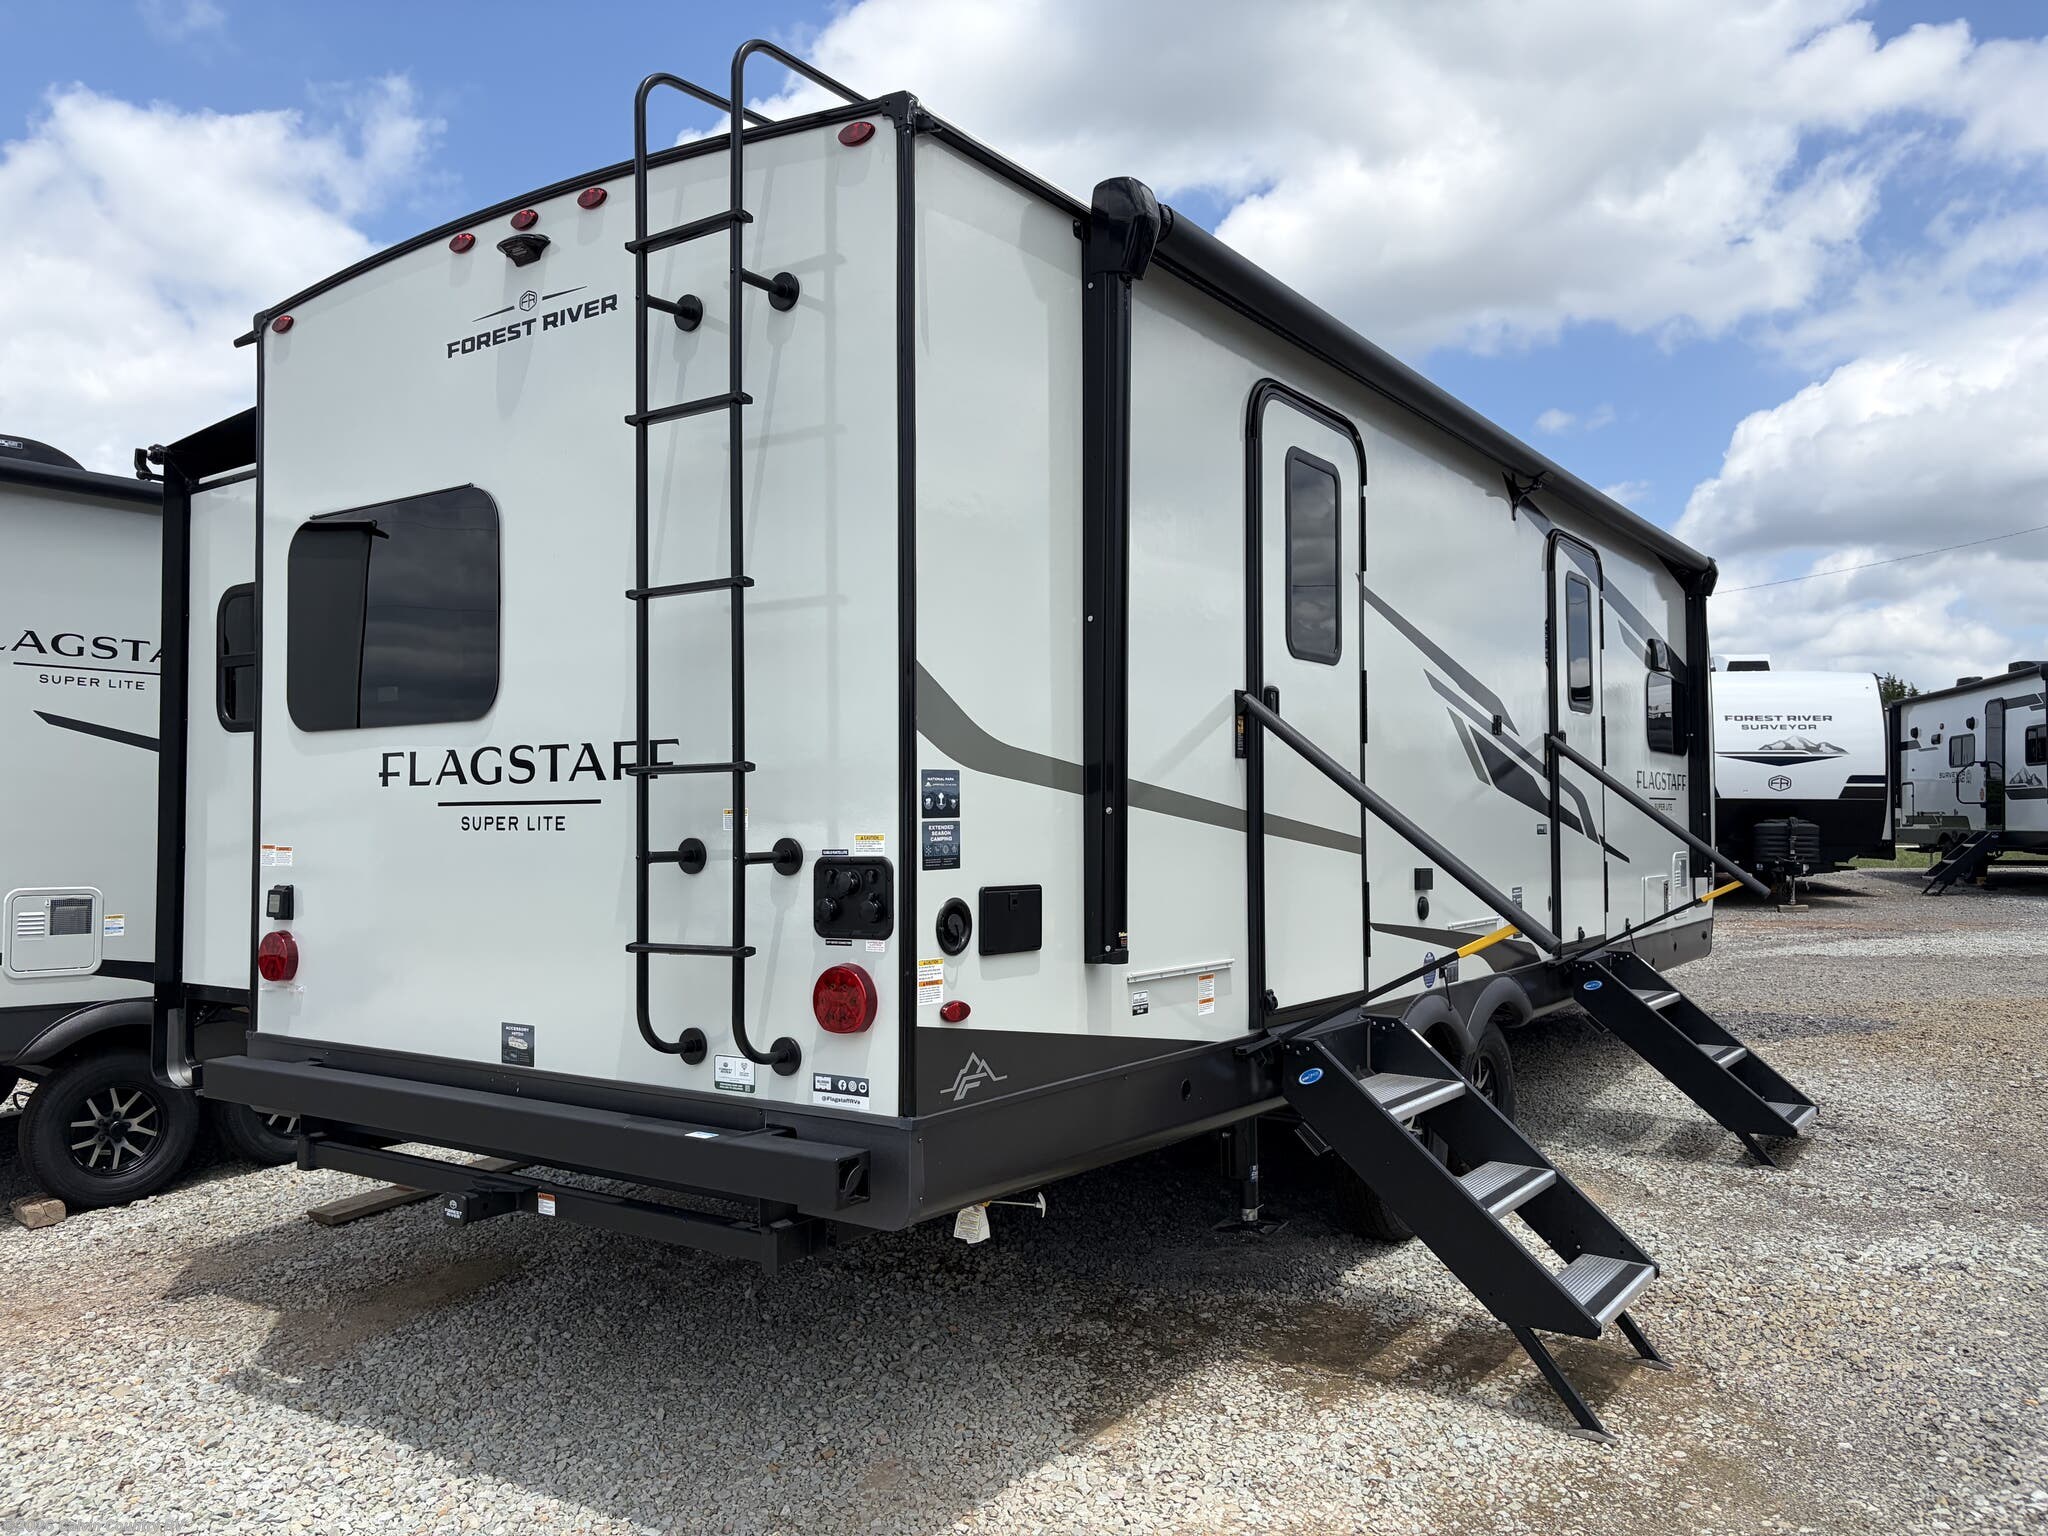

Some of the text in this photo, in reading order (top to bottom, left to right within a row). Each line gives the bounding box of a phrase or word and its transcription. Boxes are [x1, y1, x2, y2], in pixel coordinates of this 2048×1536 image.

[447, 294, 618, 359] FOREST RIVER
[39, 674, 146, 690] SUPER LITE
[1636, 770, 1687, 791] FLAGSTAFF
[461, 816, 566, 831] SUPER LITE
